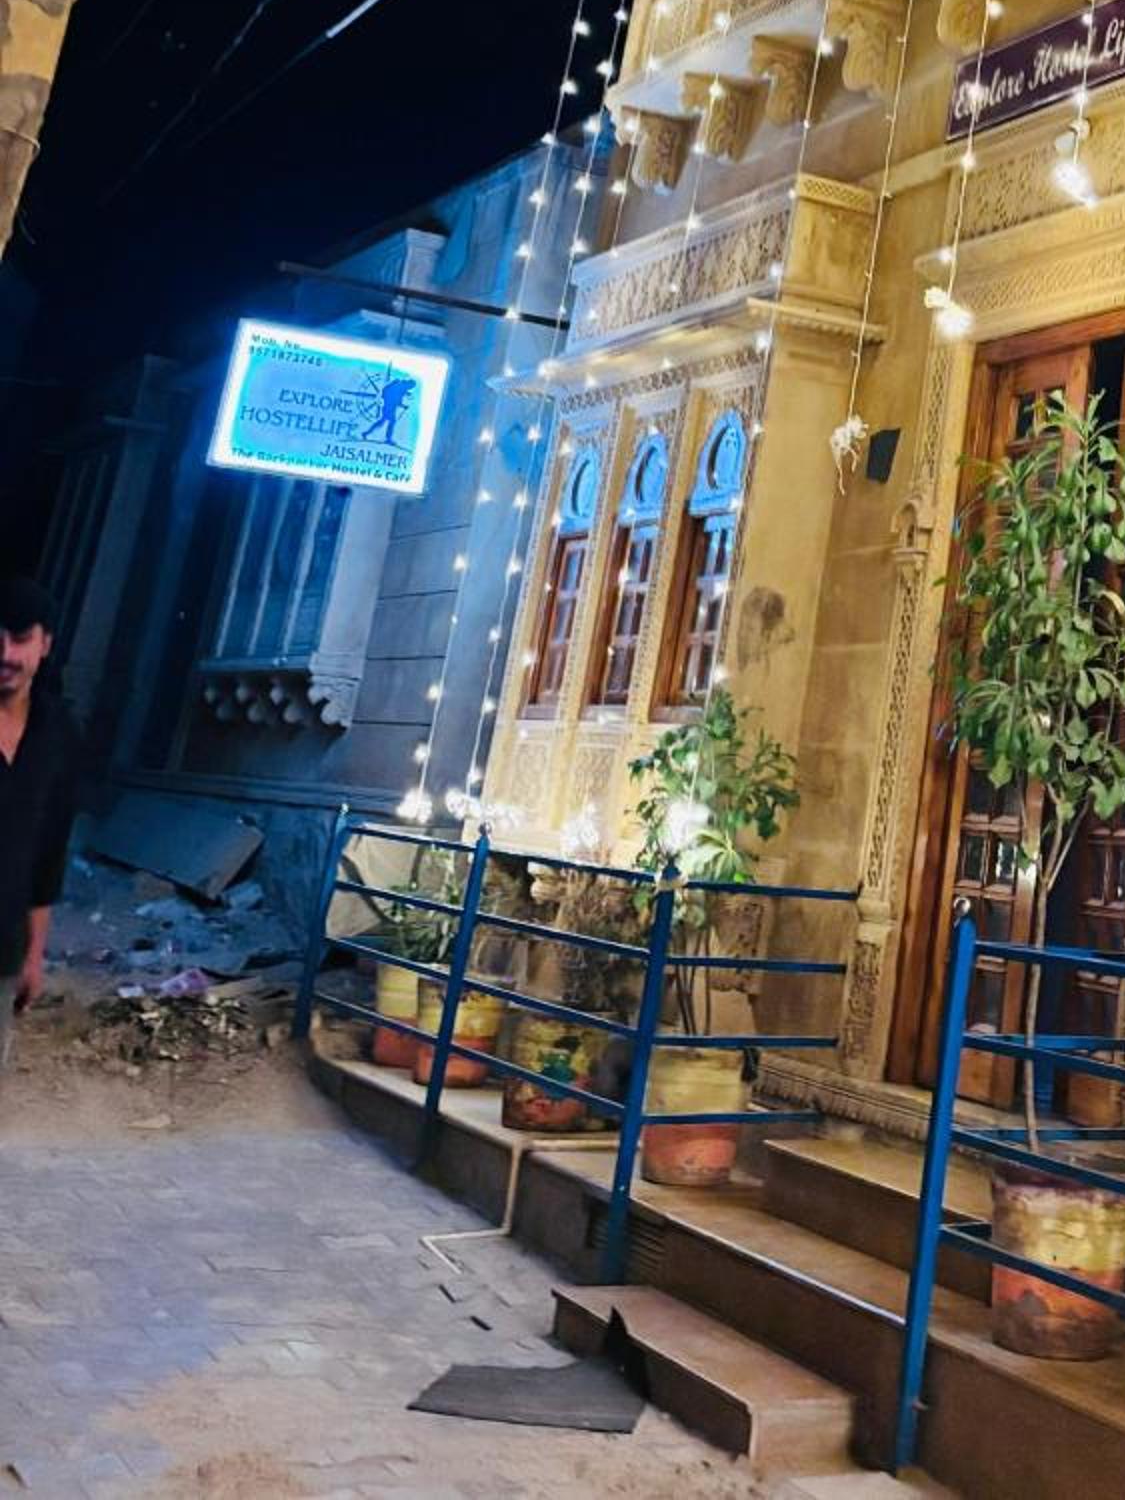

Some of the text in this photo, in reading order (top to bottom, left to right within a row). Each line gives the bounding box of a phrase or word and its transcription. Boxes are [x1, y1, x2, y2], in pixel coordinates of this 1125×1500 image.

[279, 388, 355, 413] EXPLORE
[319, 443, 409, 470] JAISALMER
[331, 463, 371, 477] Hostel
[373, 469, 383, 479] &
